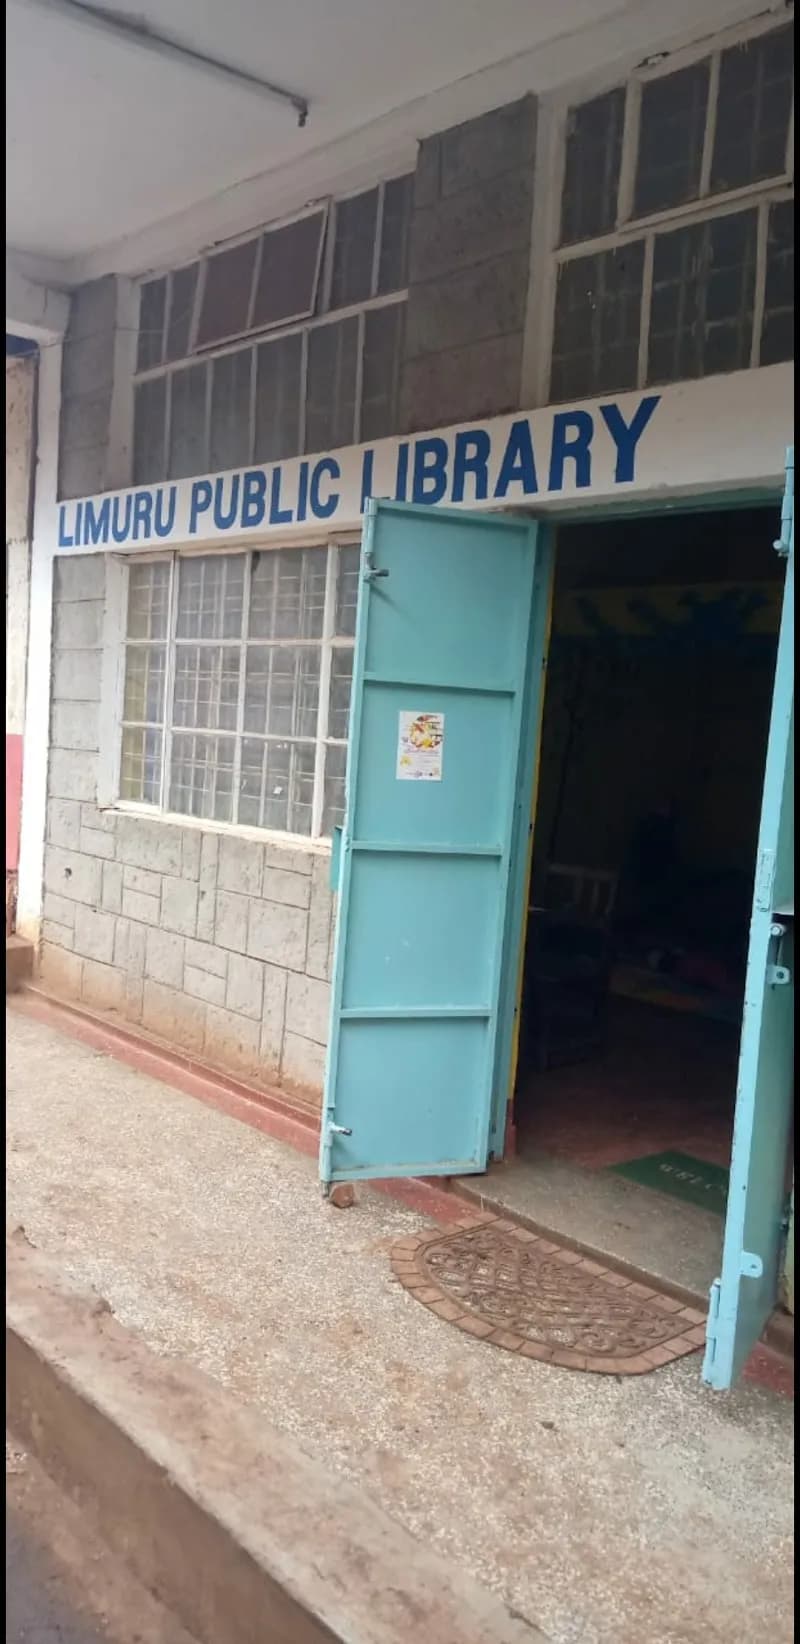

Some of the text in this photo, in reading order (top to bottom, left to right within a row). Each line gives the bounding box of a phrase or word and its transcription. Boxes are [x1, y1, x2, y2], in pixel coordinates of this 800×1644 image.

[58, 396, 661, 547] LIMURU PUBLIC LIBRARY
